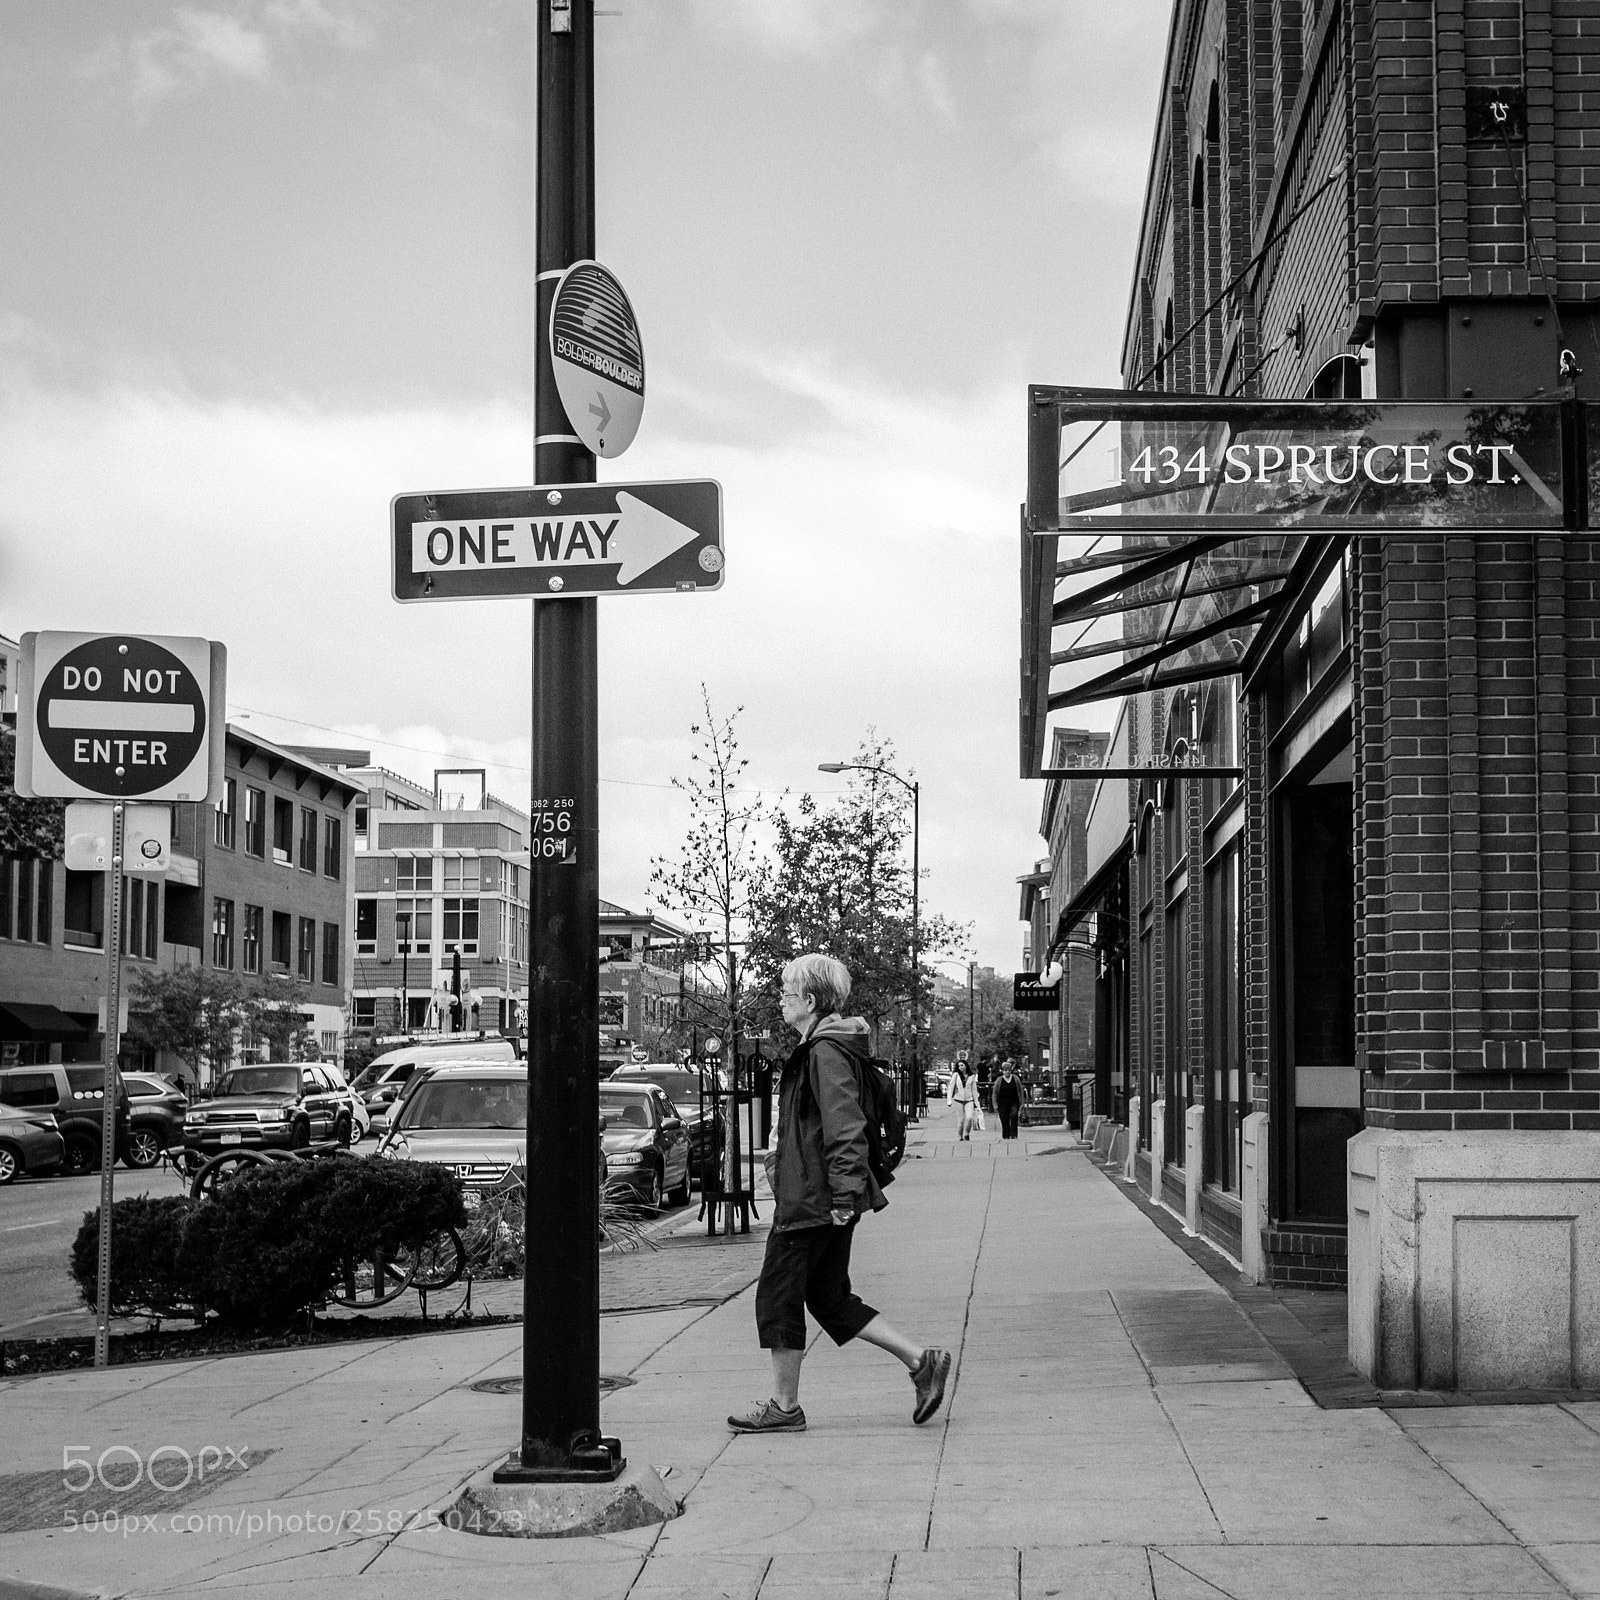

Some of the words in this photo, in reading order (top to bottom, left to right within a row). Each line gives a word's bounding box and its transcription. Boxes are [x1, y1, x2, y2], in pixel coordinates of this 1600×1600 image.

[1106, 445, 1211, 484] 1434
[1224, 444, 1432, 485] SPRUCE
[1446, 443, 1521, 485] ST.
[427, 524, 516, 566] ONE
[530, 519, 620, 561] WAY
[63, 666, 102, 691] DO
[123, 668, 181, 694] NOT
[74, 738, 168, 765] ENTER
[553, 798, 574, 808] 250
[532, 811, 571, 833] 756
